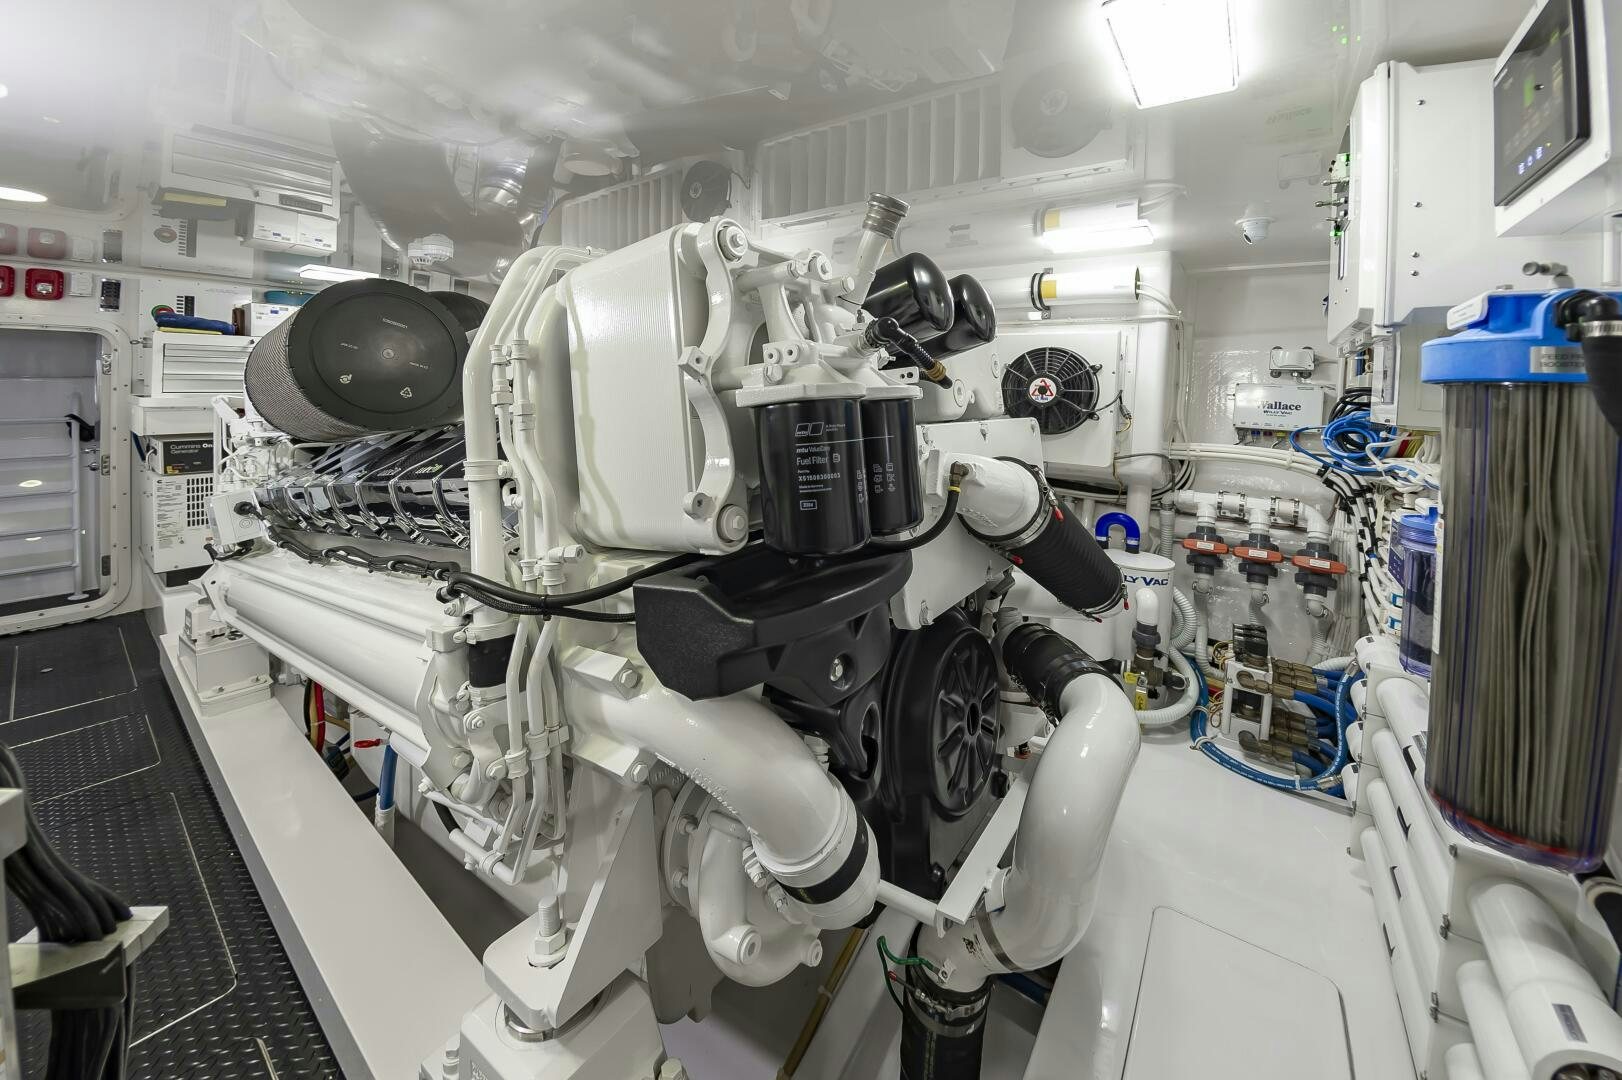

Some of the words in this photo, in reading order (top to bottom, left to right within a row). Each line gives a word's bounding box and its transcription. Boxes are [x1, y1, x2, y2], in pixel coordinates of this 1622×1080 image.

[796, 457, 811, 466] Fuel
[812, 456, 828, 464] Filter
[1140, 576, 1169, 587] VAC
